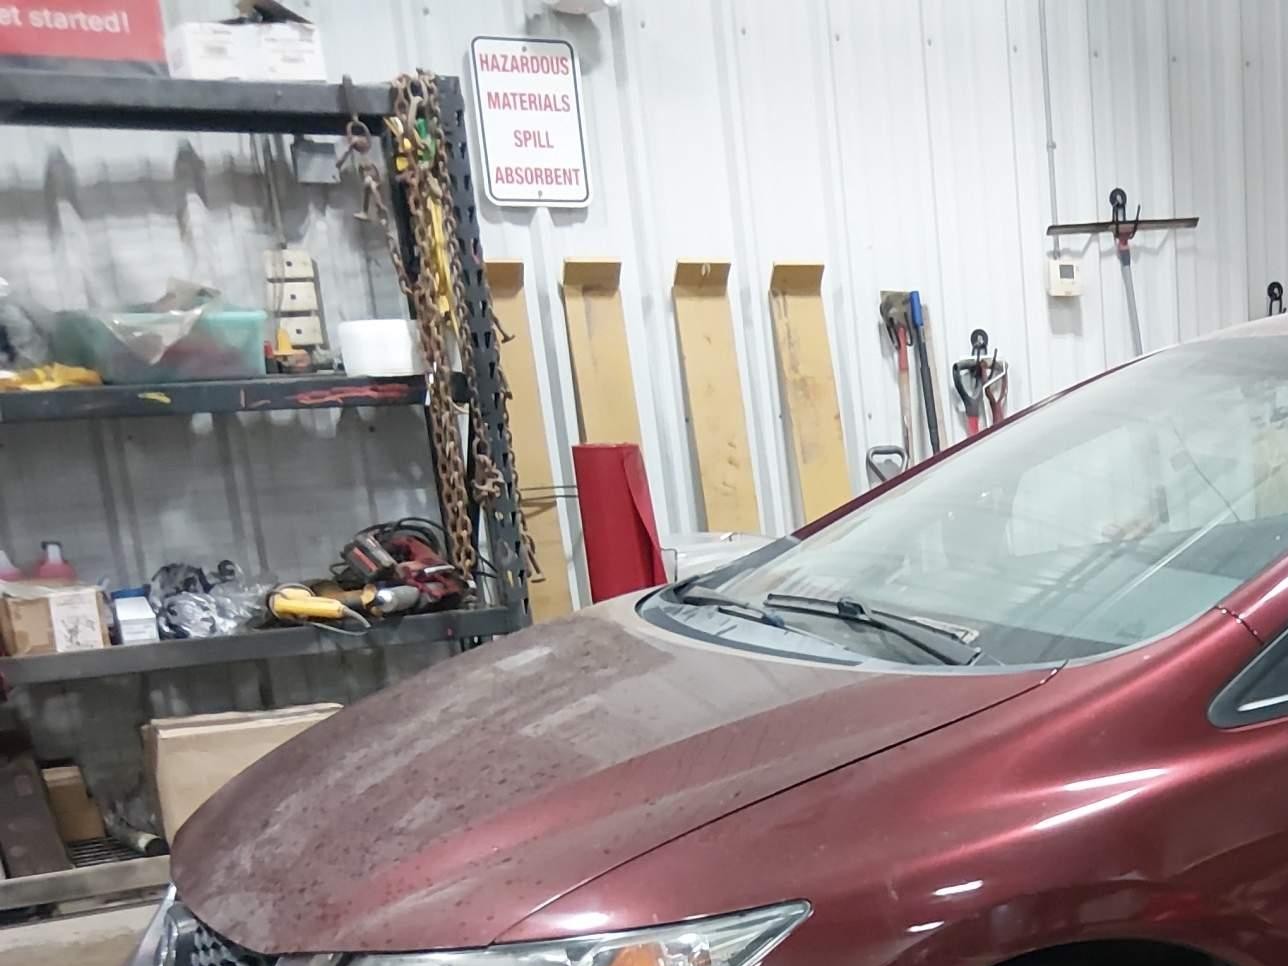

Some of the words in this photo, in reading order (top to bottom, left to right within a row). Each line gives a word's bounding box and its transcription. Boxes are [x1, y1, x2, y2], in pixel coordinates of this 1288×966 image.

[28, 9, 130, 33] started!
[479, 54, 570, 76] HAZARDOUS
[487, 91, 571, 113] MATERIALS
[513, 129, 555, 149] SPILL
[495, 166, 580, 186] ABSORBENT
